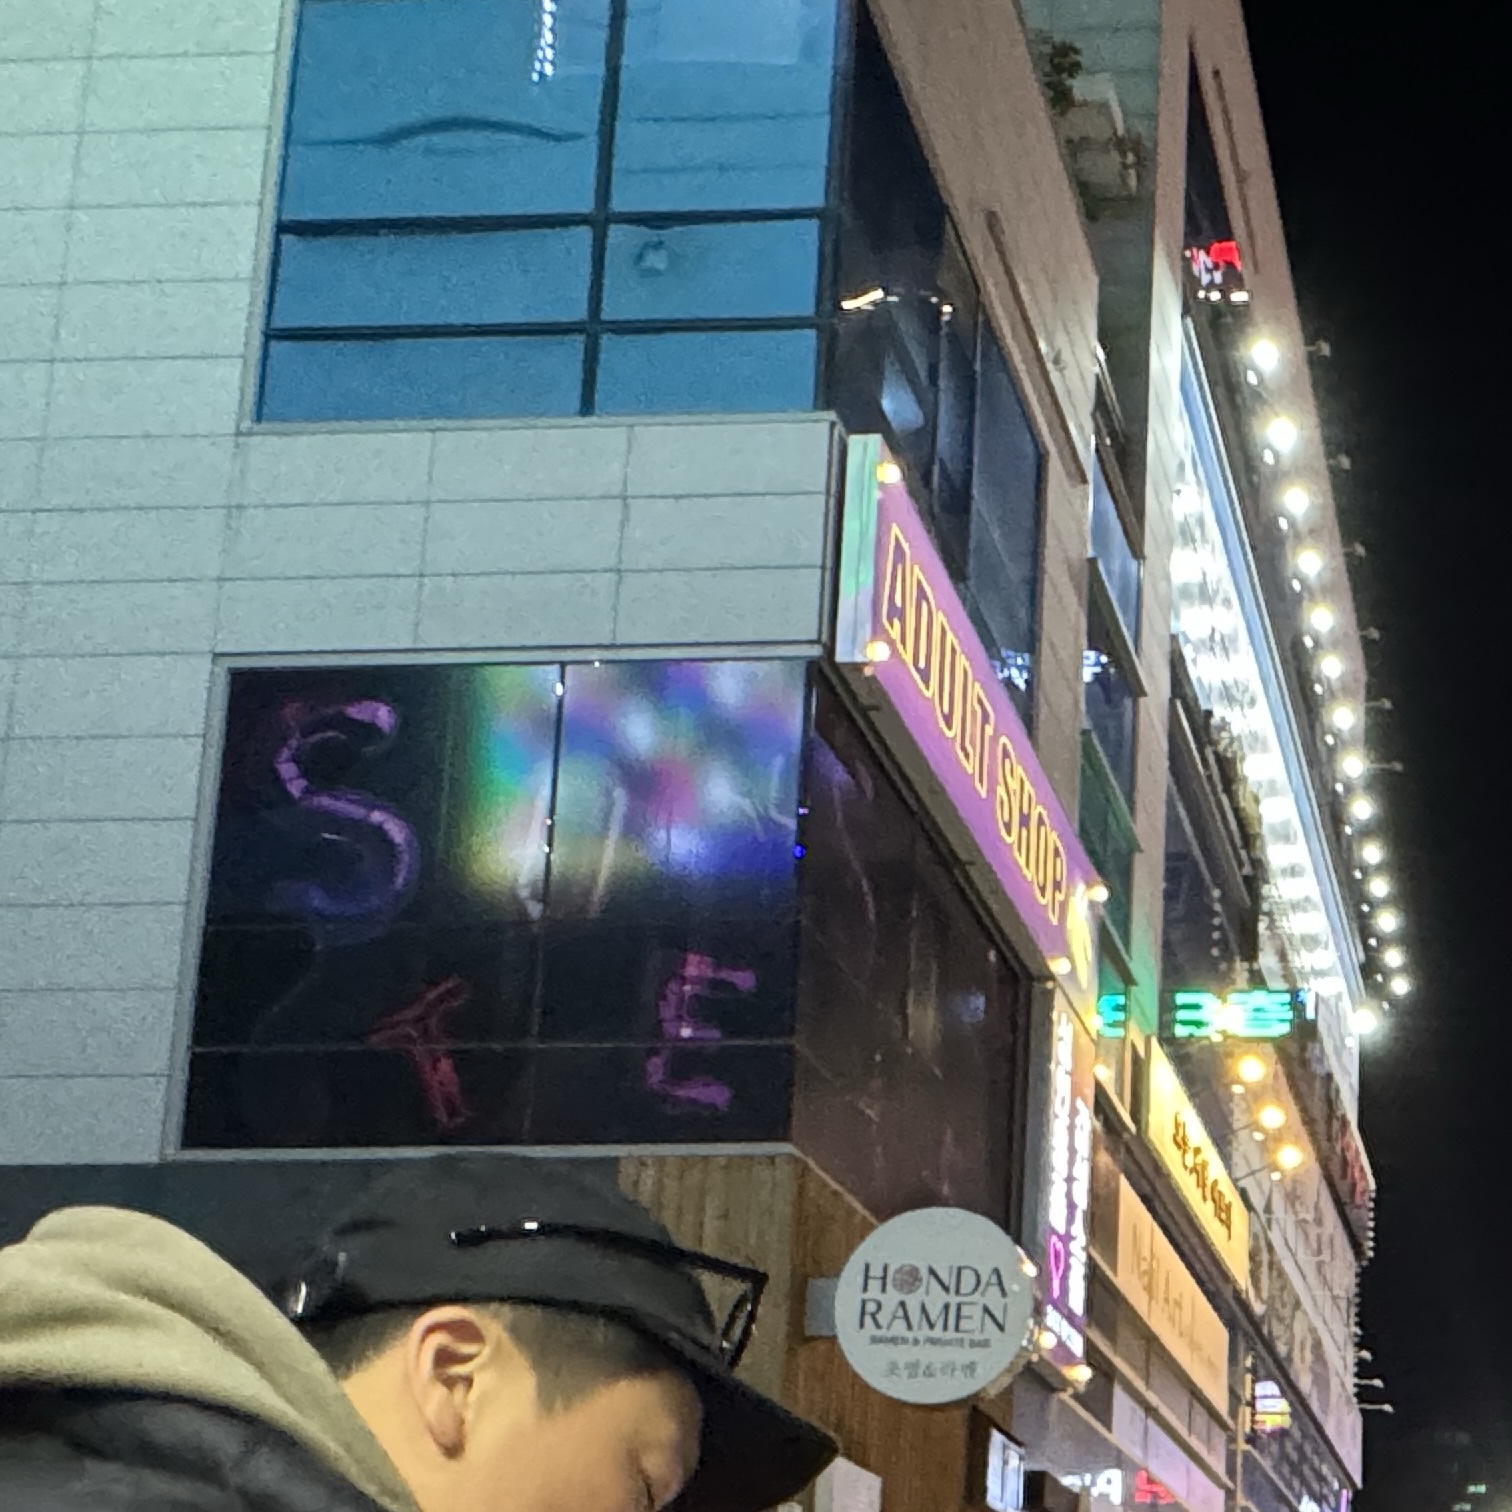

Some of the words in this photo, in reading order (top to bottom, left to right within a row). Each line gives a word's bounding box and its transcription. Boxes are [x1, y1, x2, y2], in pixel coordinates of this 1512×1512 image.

[881, 521, 994, 799] ADULT
[996, 735, 1068, 926] SHOP
[861, 1260, 1009, 1299] HONDA
[857, 1297, 1009, 1335] RAMEN
